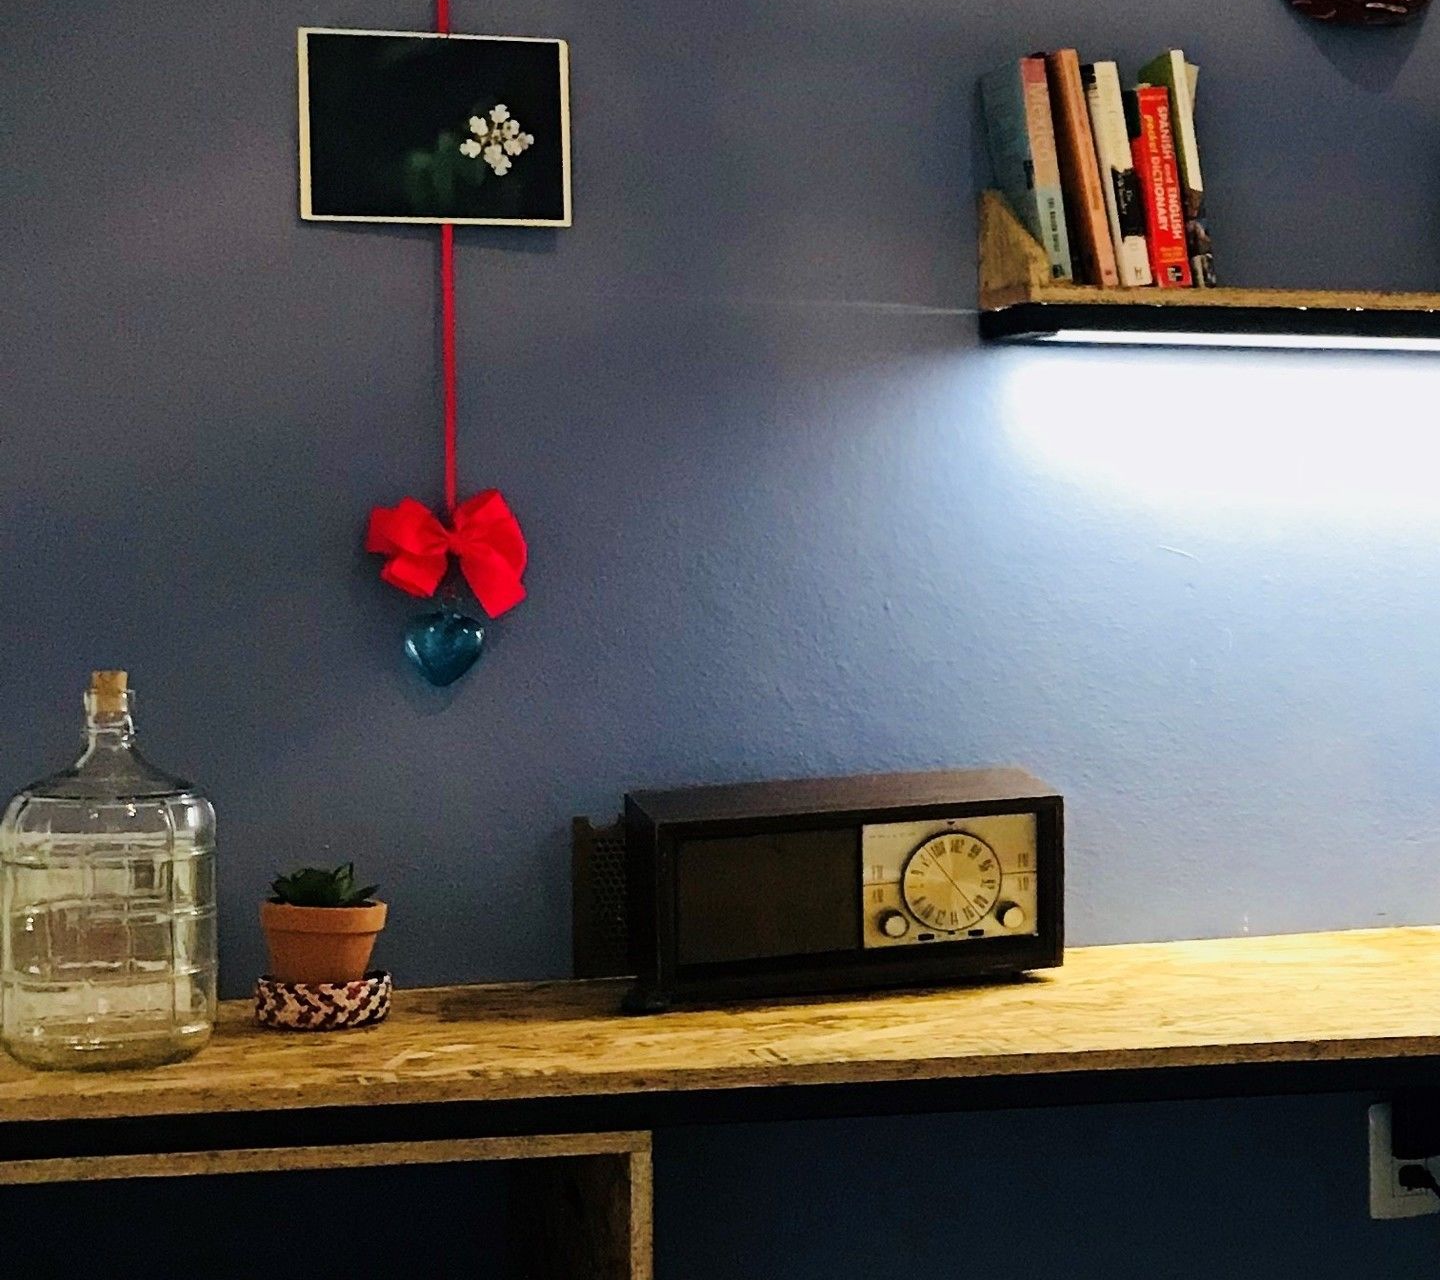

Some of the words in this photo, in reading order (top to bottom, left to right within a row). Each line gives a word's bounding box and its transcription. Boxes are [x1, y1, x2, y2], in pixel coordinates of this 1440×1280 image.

[1143, 114, 1158, 156] pocket
[1151, 156, 1169, 232] DICTIONARY
[1157, 105, 1175, 159] SPANISH
[1166, 186, 1183, 239] ENGLISH
